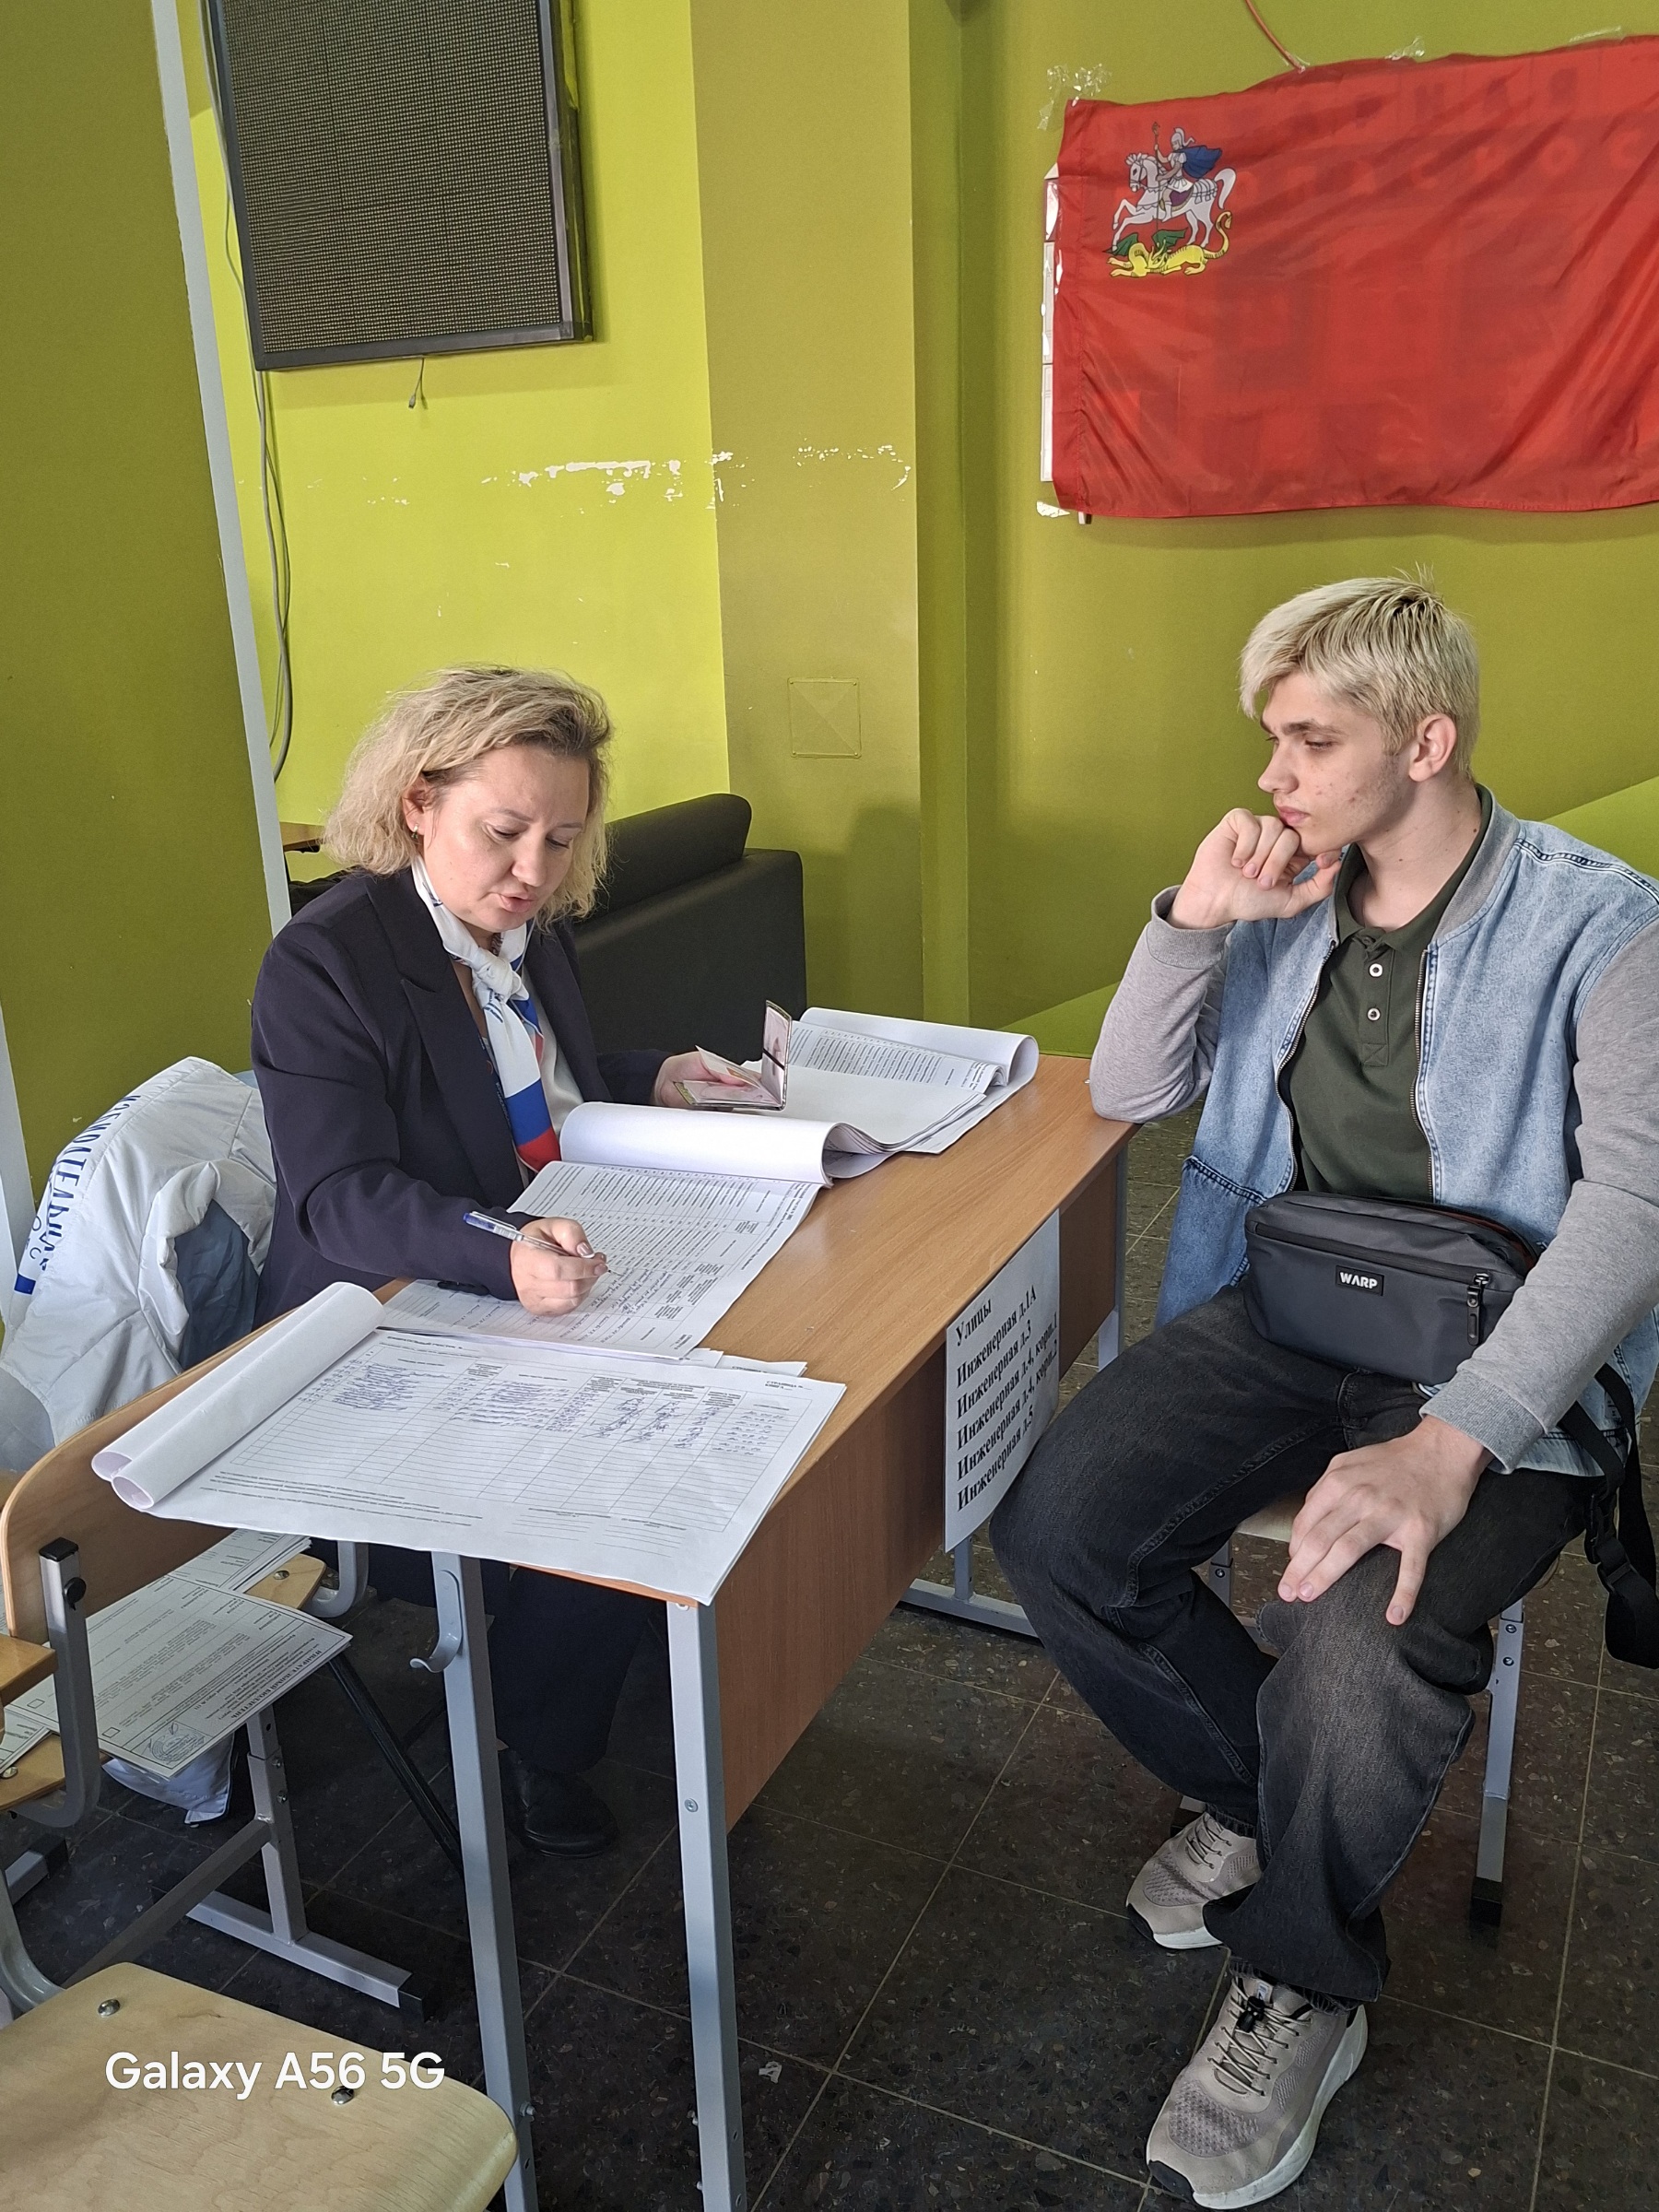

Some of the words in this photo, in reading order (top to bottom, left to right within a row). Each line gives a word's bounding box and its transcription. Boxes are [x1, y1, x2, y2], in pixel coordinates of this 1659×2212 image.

[1339, 1272, 1378, 1289] WARP
[955, 1299, 992, 1347] Улицы
[957, 1311, 1018, 1388] Инженерная
[957, 1340, 1019, 1419] Инженерная
[1019, 1319, 1031, 1350] д.3
[957, 1370, 1020, 1451] Инженерная
[958, 1398, 1020, 1481] Инженерная
[958, 1427, 1021, 1512] Инженерная
